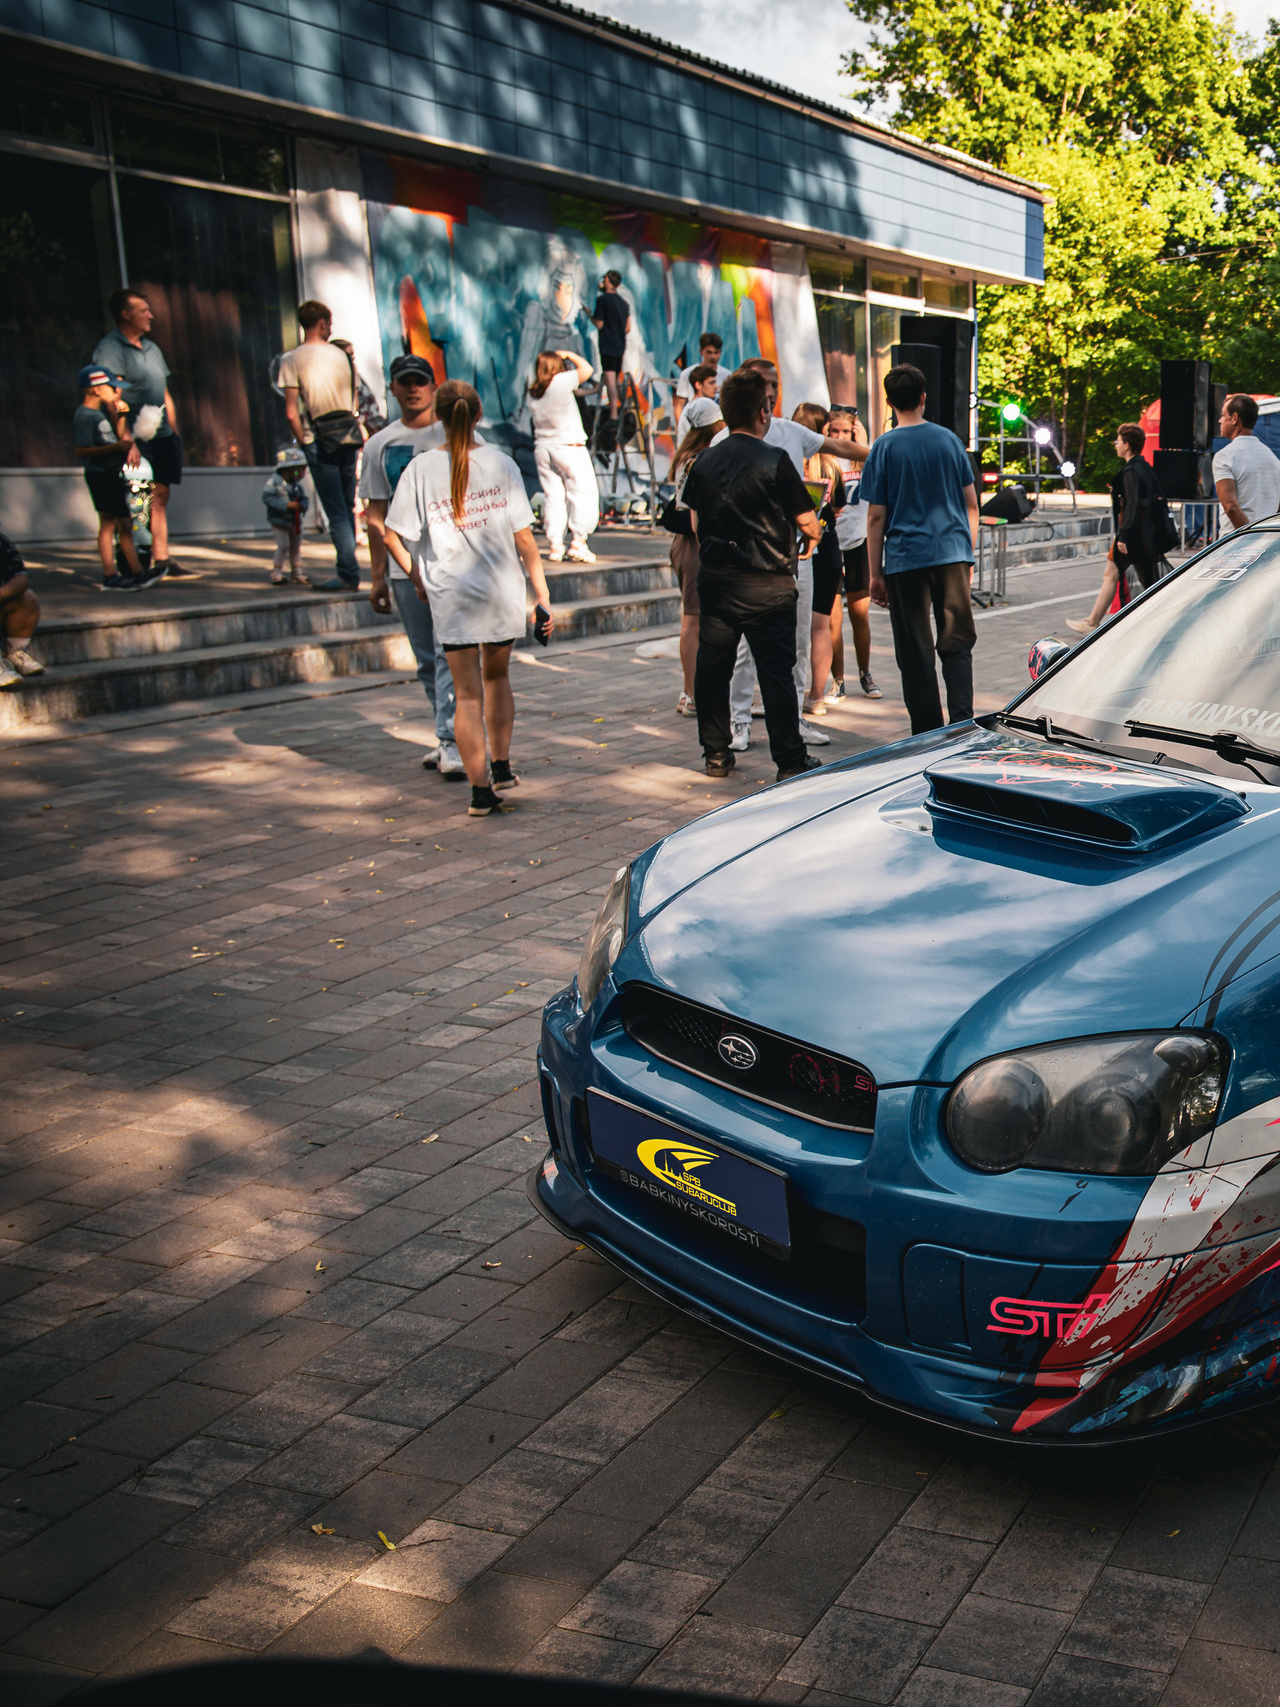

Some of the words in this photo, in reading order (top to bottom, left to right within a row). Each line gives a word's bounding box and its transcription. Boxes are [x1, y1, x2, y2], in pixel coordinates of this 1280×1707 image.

[854, 1074, 877, 1094] ST
[682, 1171, 701, 1187] SPB
[629, 1174, 760, 1248] BABKINYSKOROSTI
[675, 1181, 737, 1217] SUBARUCLUB
